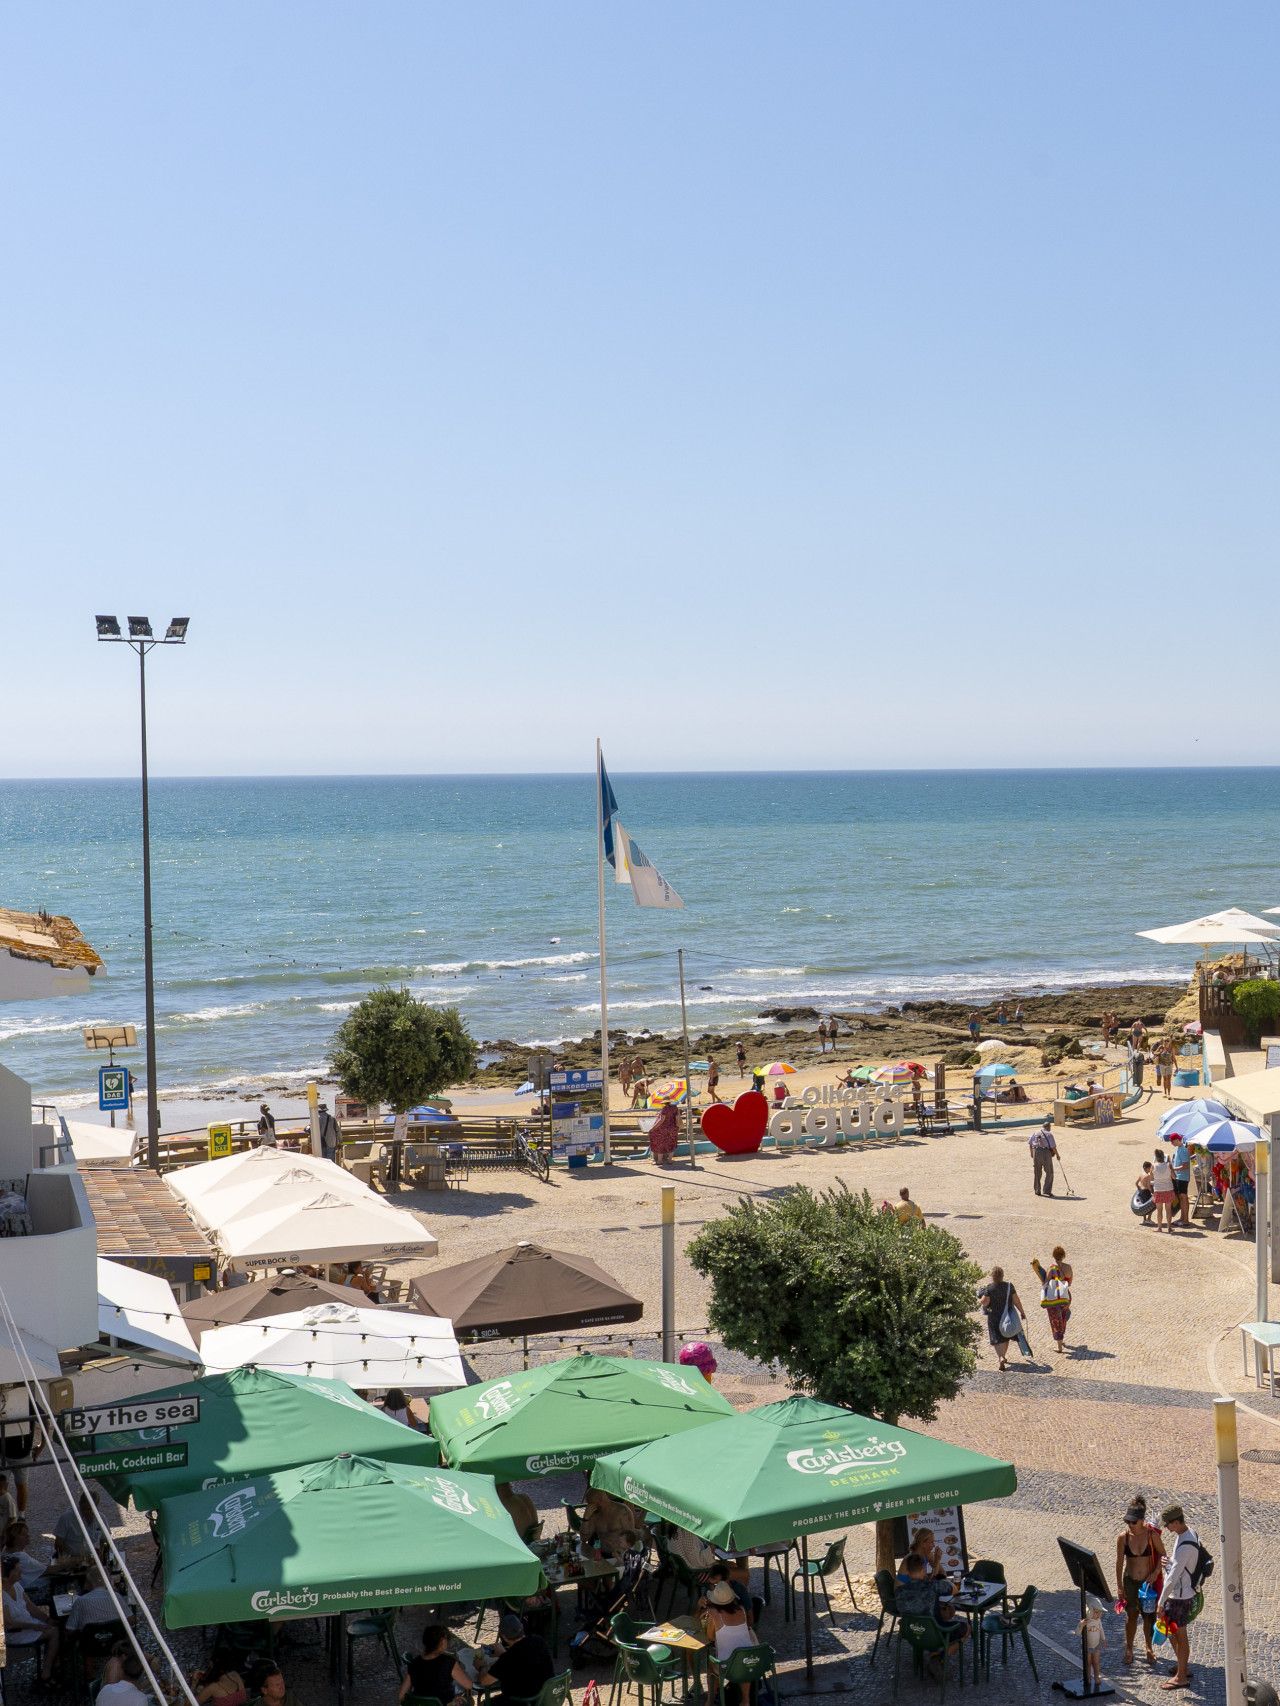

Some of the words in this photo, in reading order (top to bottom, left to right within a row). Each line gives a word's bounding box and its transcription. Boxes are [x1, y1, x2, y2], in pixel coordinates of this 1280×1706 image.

[875, 1081, 902, 1099] de
[769, 1097, 904, 1147] água
[245, 1259, 267, 1267] SUPER
[268, 1256, 287, 1265] BOCK
[481, 1328, 500, 1338] SICAL
[70, 1413, 102, 1434] By
[107, 1408, 148, 1426] the
[155, 1403, 195, 1421] sea
[80, 1459, 120, 1474] Brunch,
[122, 1453, 163, 1468] Cocktail
[166, 1452, 185, 1463] Bar
[526, 1451, 580, 1475] Carlsberg
[787, 1437, 907, 1476] Carlsberg
[830, 1467, 900, 1487] DENMARK
[792, 1513, 833, 1527] PROBABLY
[835, 1510, 849, 1519] THE
[852, 1505, 870, 1516] BEST
[885, 1499, 904, 1509] BEER
[907, 1497, 915, 1505] IN
[917, 1494, 931, 1503] THE
[933, 1489, 960, 1500] WORLD
[251, 1587, 320, 1615] Carlsberg
[322, 1591, 358, 1601] Probably
[360, 1589, 373, 1597] the
[375, 1588, 392, 1596] Best
[394, 1586, 413, 1594] Beer
[424, 1584, 437, 1592] the
[438, 1582, 462, 1591] World
